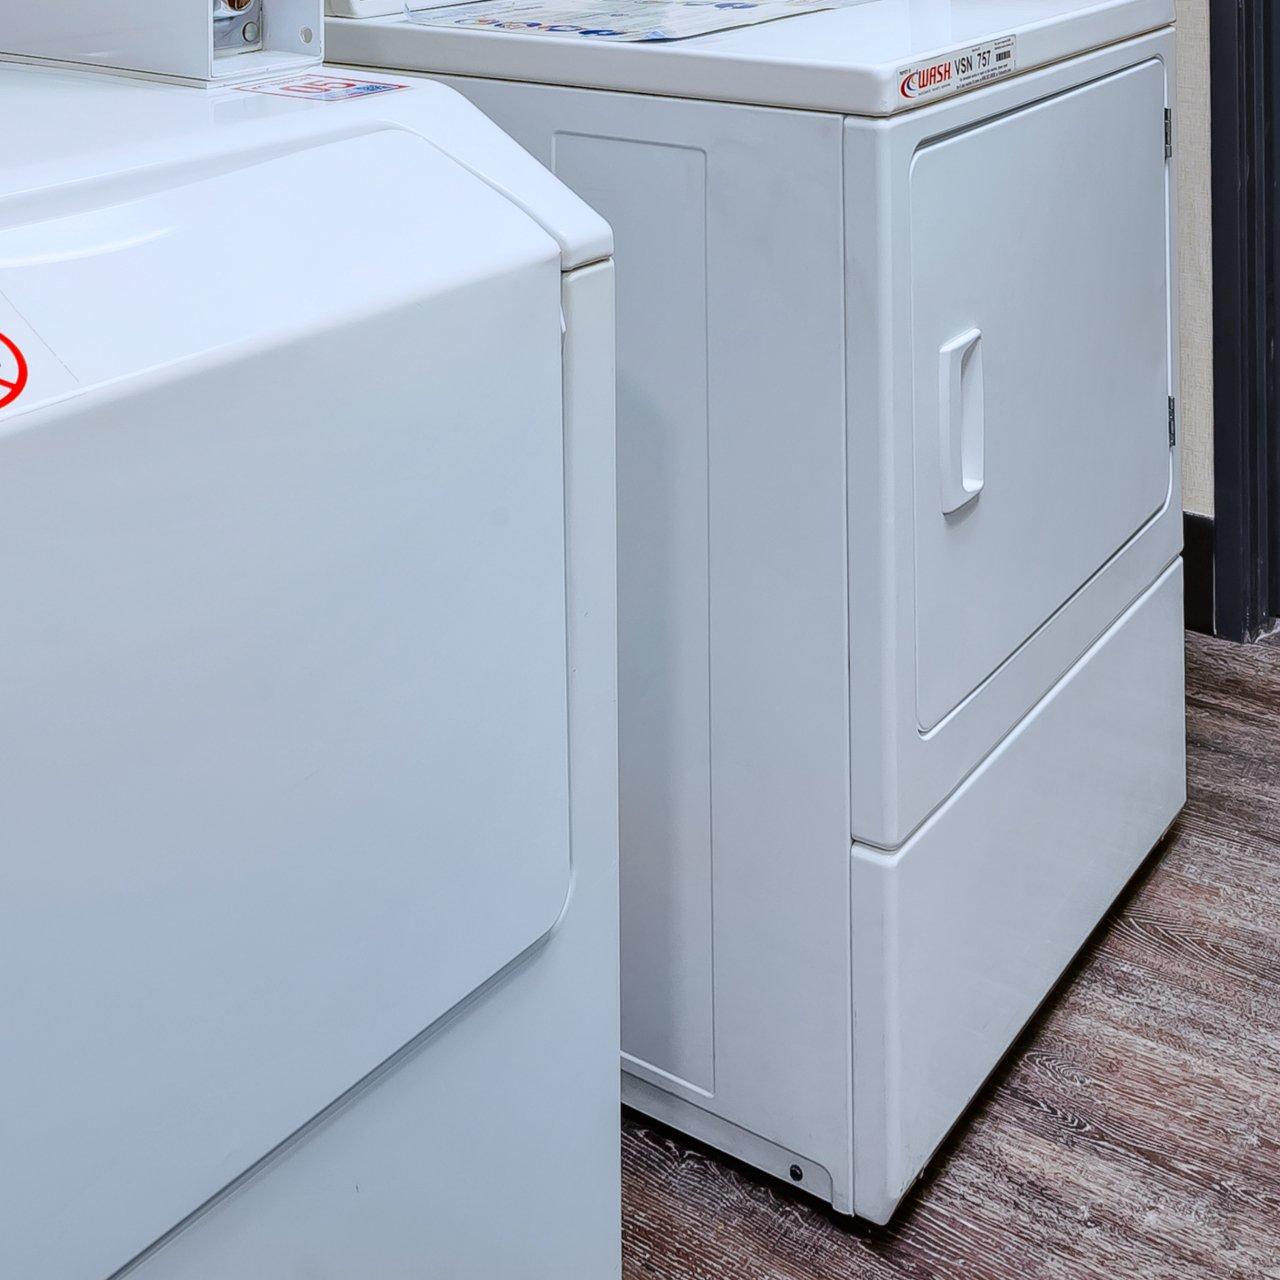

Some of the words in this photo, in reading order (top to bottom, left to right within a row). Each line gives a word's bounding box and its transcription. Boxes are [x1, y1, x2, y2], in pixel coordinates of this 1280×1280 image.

[918, 62, 950, 88] WASH
[954, 56, 972, 76] VSN
[977, 50, 990, 69] 757
